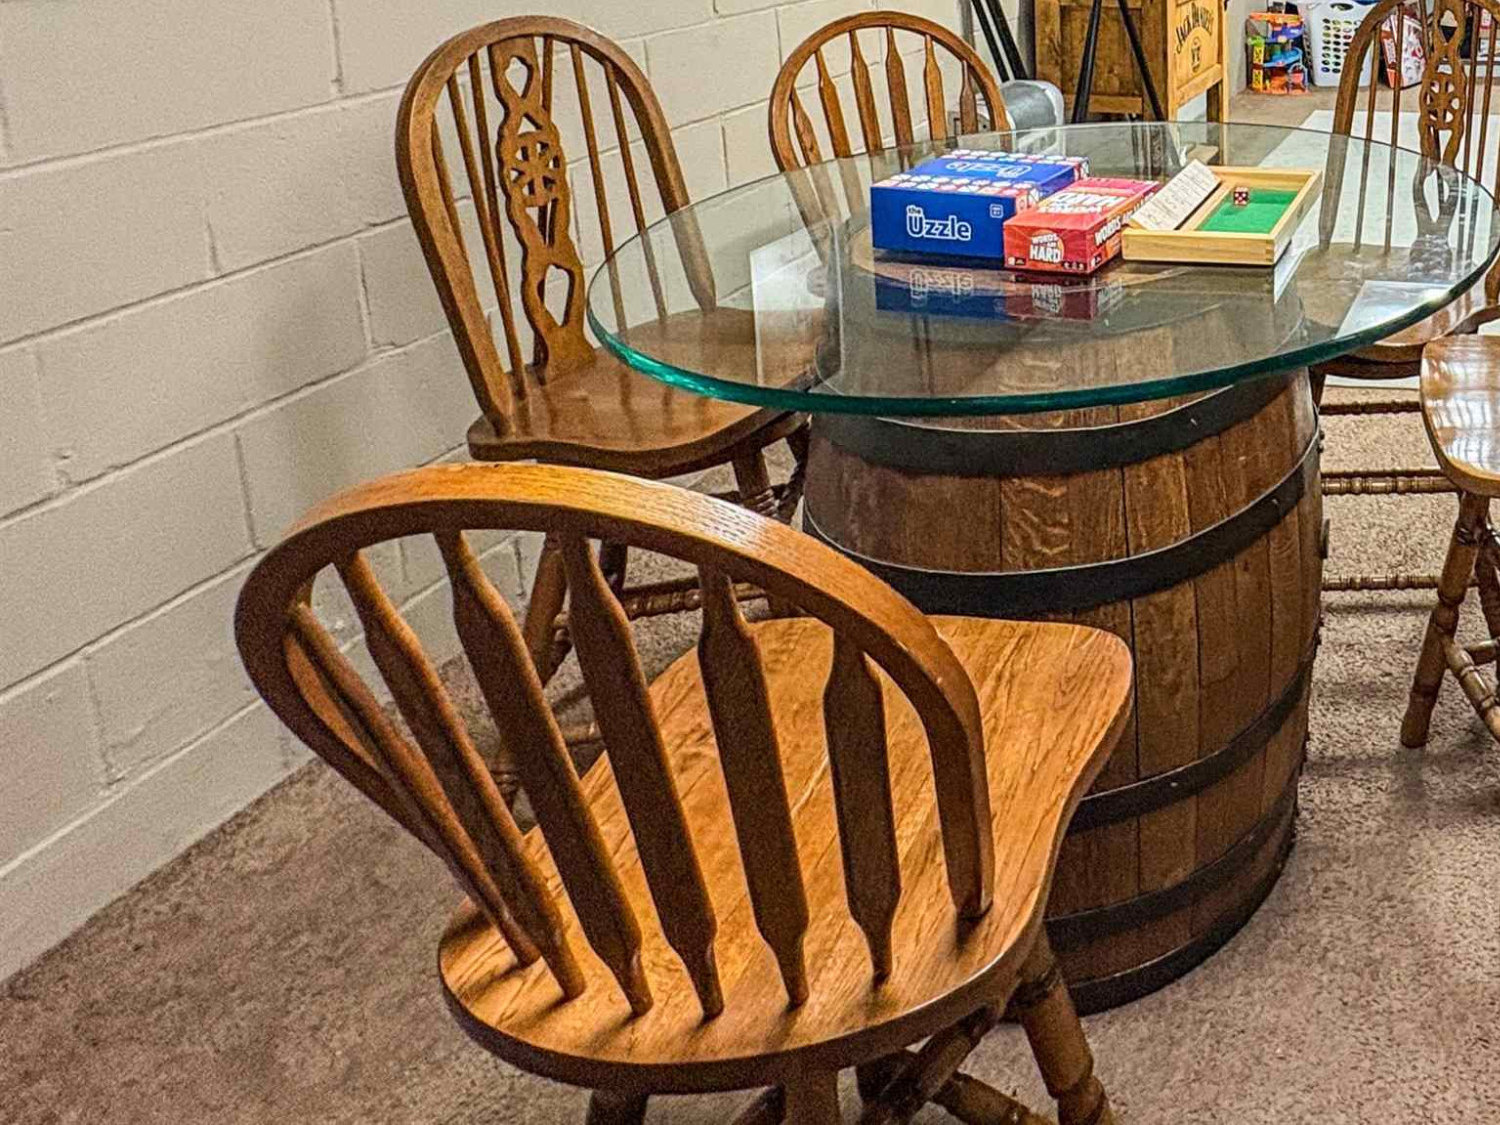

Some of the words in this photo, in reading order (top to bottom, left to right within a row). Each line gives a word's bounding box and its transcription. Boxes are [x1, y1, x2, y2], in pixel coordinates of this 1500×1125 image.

[906, 205, 922, 215] the
[906, 215, 971, 241] Uzzle
[1095, 215, 1121, 247] WORDS
[1032, 232, 1060, 245] WORDS
[1030, 244, 1062, 263] HARD
